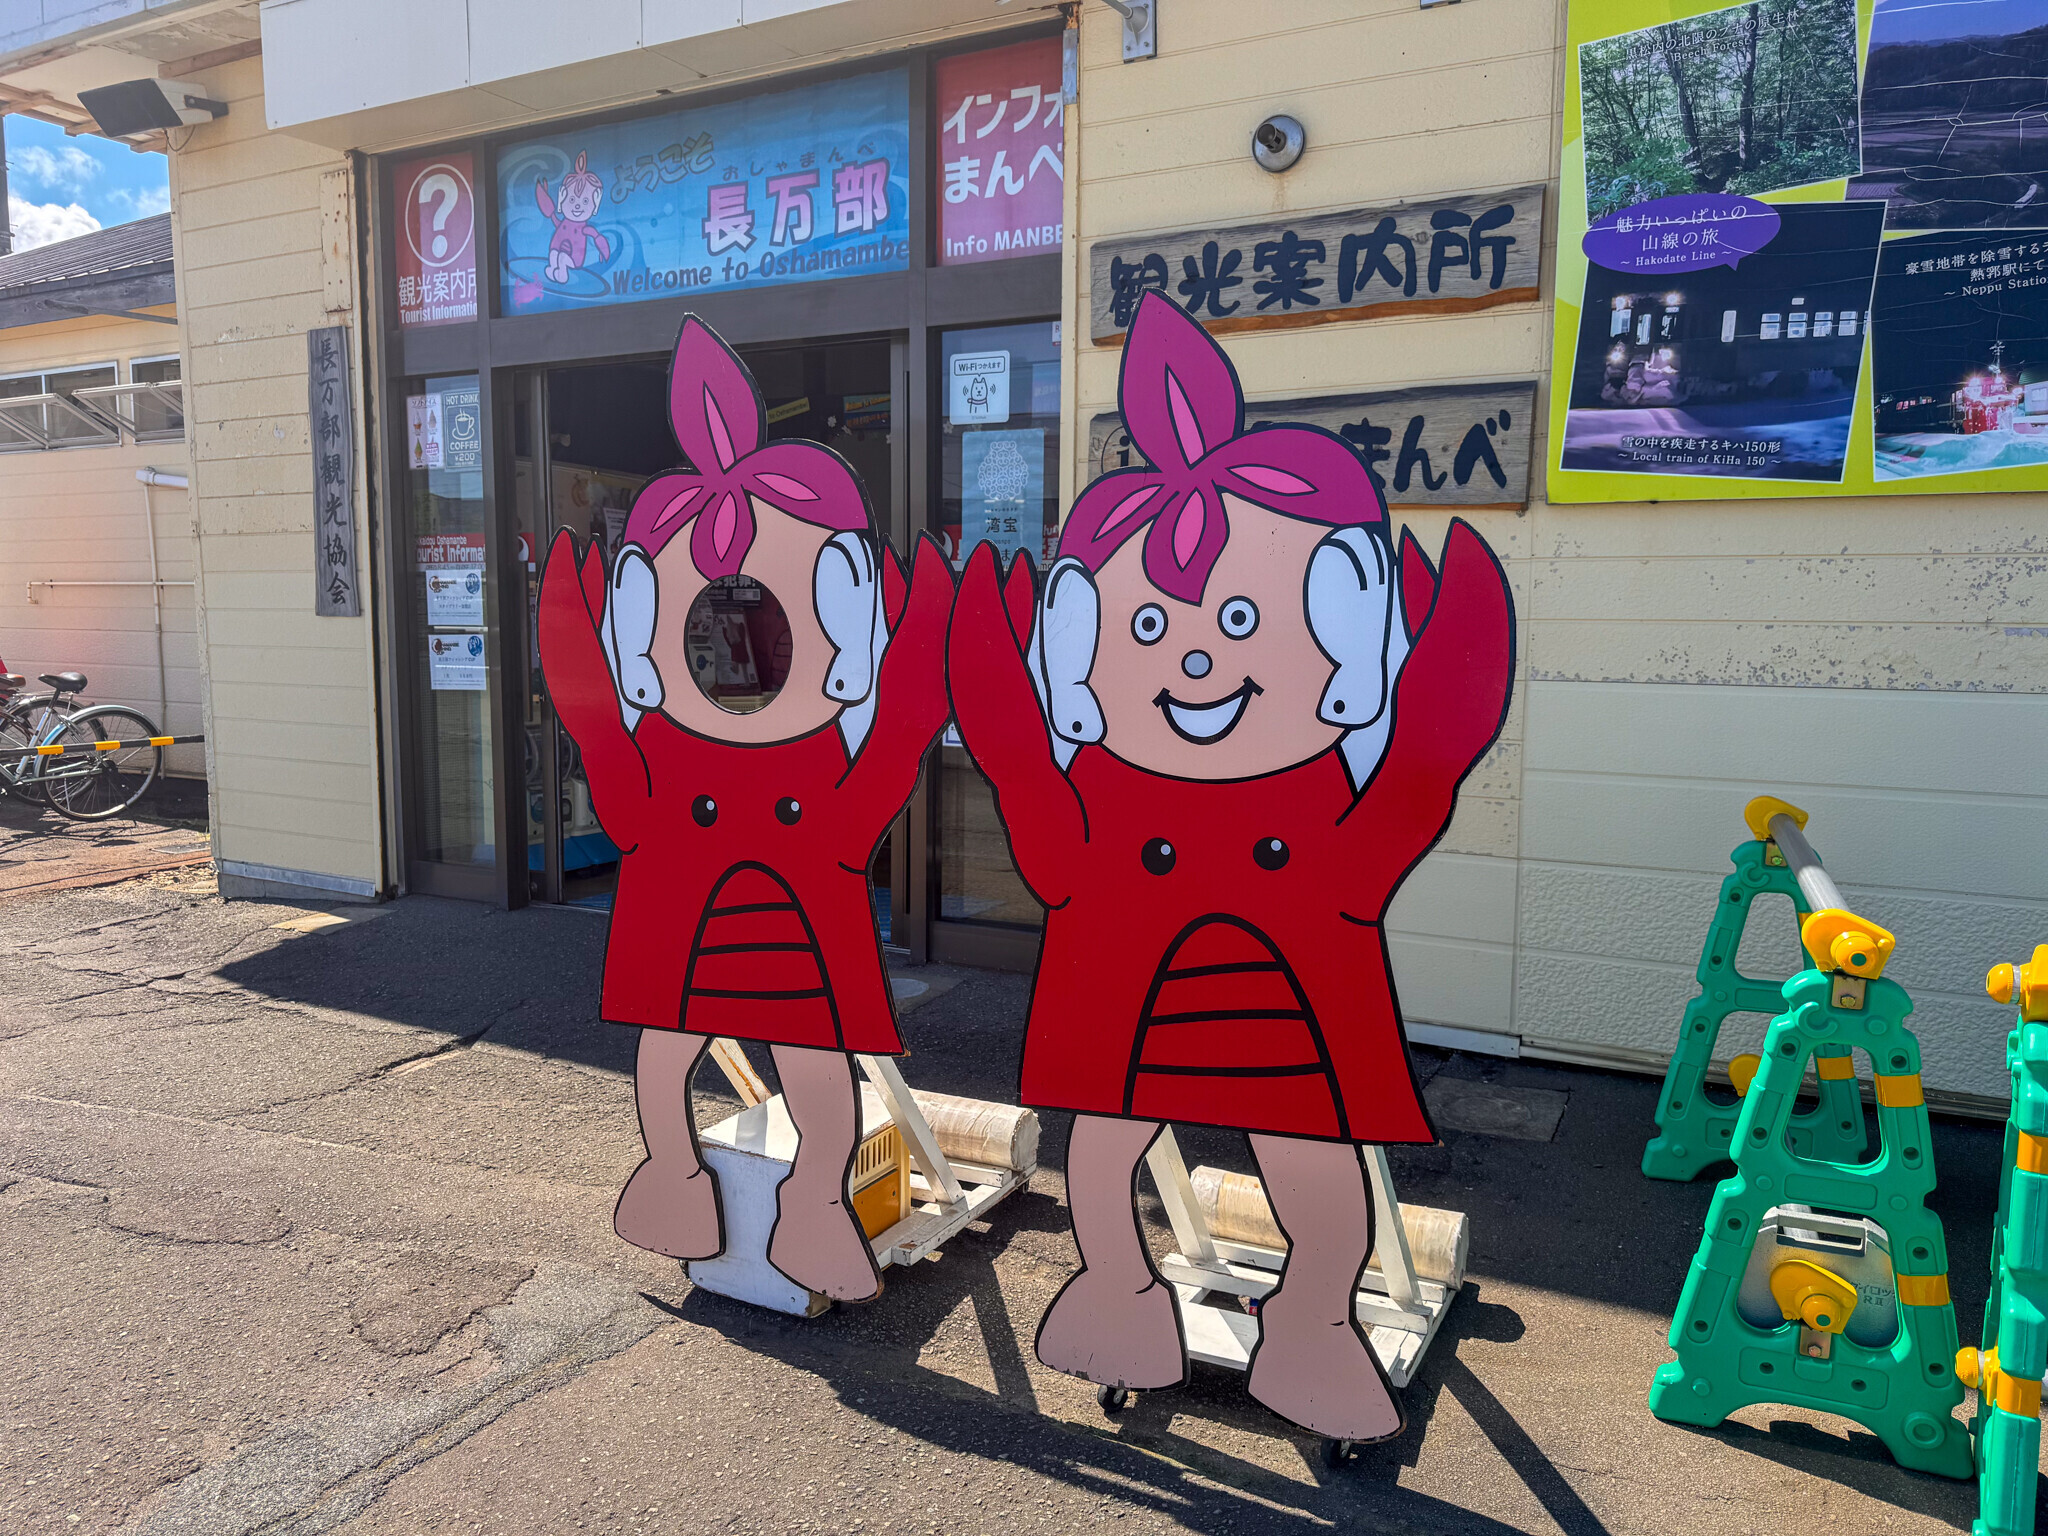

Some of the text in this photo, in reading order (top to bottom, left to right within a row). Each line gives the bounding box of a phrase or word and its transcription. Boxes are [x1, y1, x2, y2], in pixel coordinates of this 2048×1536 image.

[1625, 7, 1800, 60] 黒松内の北限のブナの原生林
[1673, 37, 1749, 62] Beech Forest
[610, 131, 715, 205] ようこそ
[722, 142, 875, 182] おしゃまんべ
[701, 156, 891, 257] 長万部
[1616, 205, 1747, 233] 魅力いっぱいの
[946, 235, 988, 257] Info
[1642, 228, 1719, 252] 山線の旅
[613, 234, 910, 295] Welcome to Oshamambe
[1110, 204, 1517, 328] 観光案内所
[1635, 251, 1716, 267] Hakodate Line
[1961, 275, 2048, 297] Neppu Statio
[400, 306, 431, 324] Tourist
[445, 395, 459, 406] HOT
[449, 440, 479, 451] COFFEE
[454, 452, 476, 461] ¥200
[1622, 436, 1782, 454] 雪の中を疾走するキハ150形
[1632, 451, 1766, 466] Local train of KiHa 150
[317, 339, 350, 605] 長万部観光協会
[985, 516, 1018, 534] 湾宝
